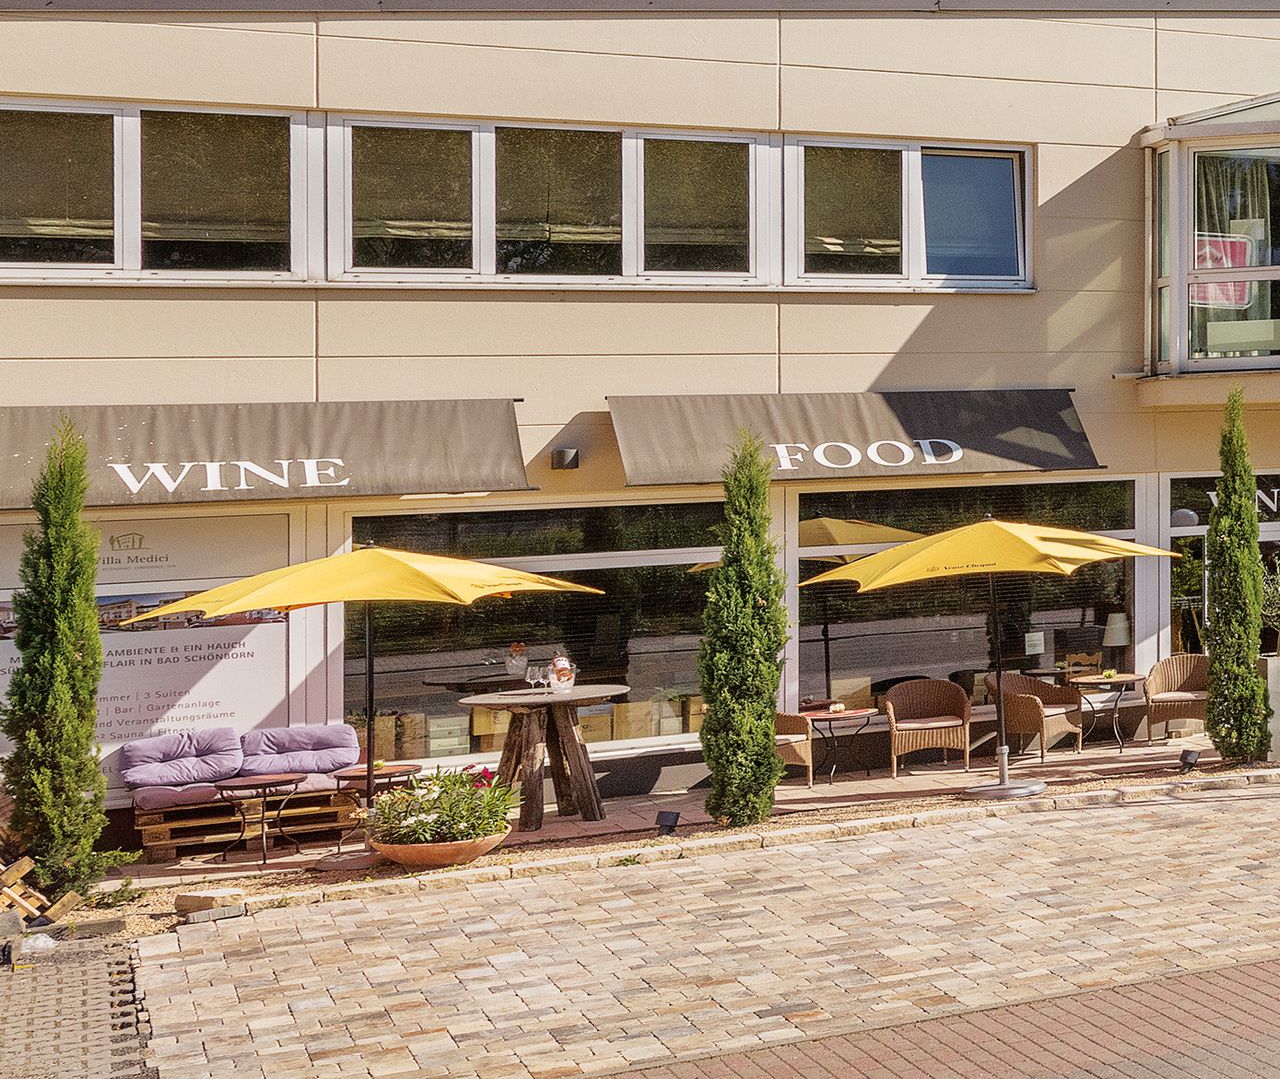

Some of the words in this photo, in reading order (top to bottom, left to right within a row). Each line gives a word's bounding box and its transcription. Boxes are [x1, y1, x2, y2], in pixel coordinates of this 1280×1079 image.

[769, 439, 964, 470] FOOD
[107, 458, 350, 494] WINE
[127, 554, 169, 564] Medici
[106, 646, 166, 657] AMBIENTE
[184, 644, 202, 653] EIN
[207, 641, 246, 651] HAUCH
[103, 657, 135, 668] FLAIR
[140, 658, 152, 666] IN
[157, 656, 180, 664] BAD
[184, 651, 255, 663] SCHÖNBORN
[144, 692, 151, 700] 3
[155, 690, 190, 699] Suiten
[114, 706, 134, 714] Bar
[146, 700, 221, 712] Gartenanlage
[116, 712, 236, 727] Veranstaltungsräume
[109, 732, 144, 740] Sauna
